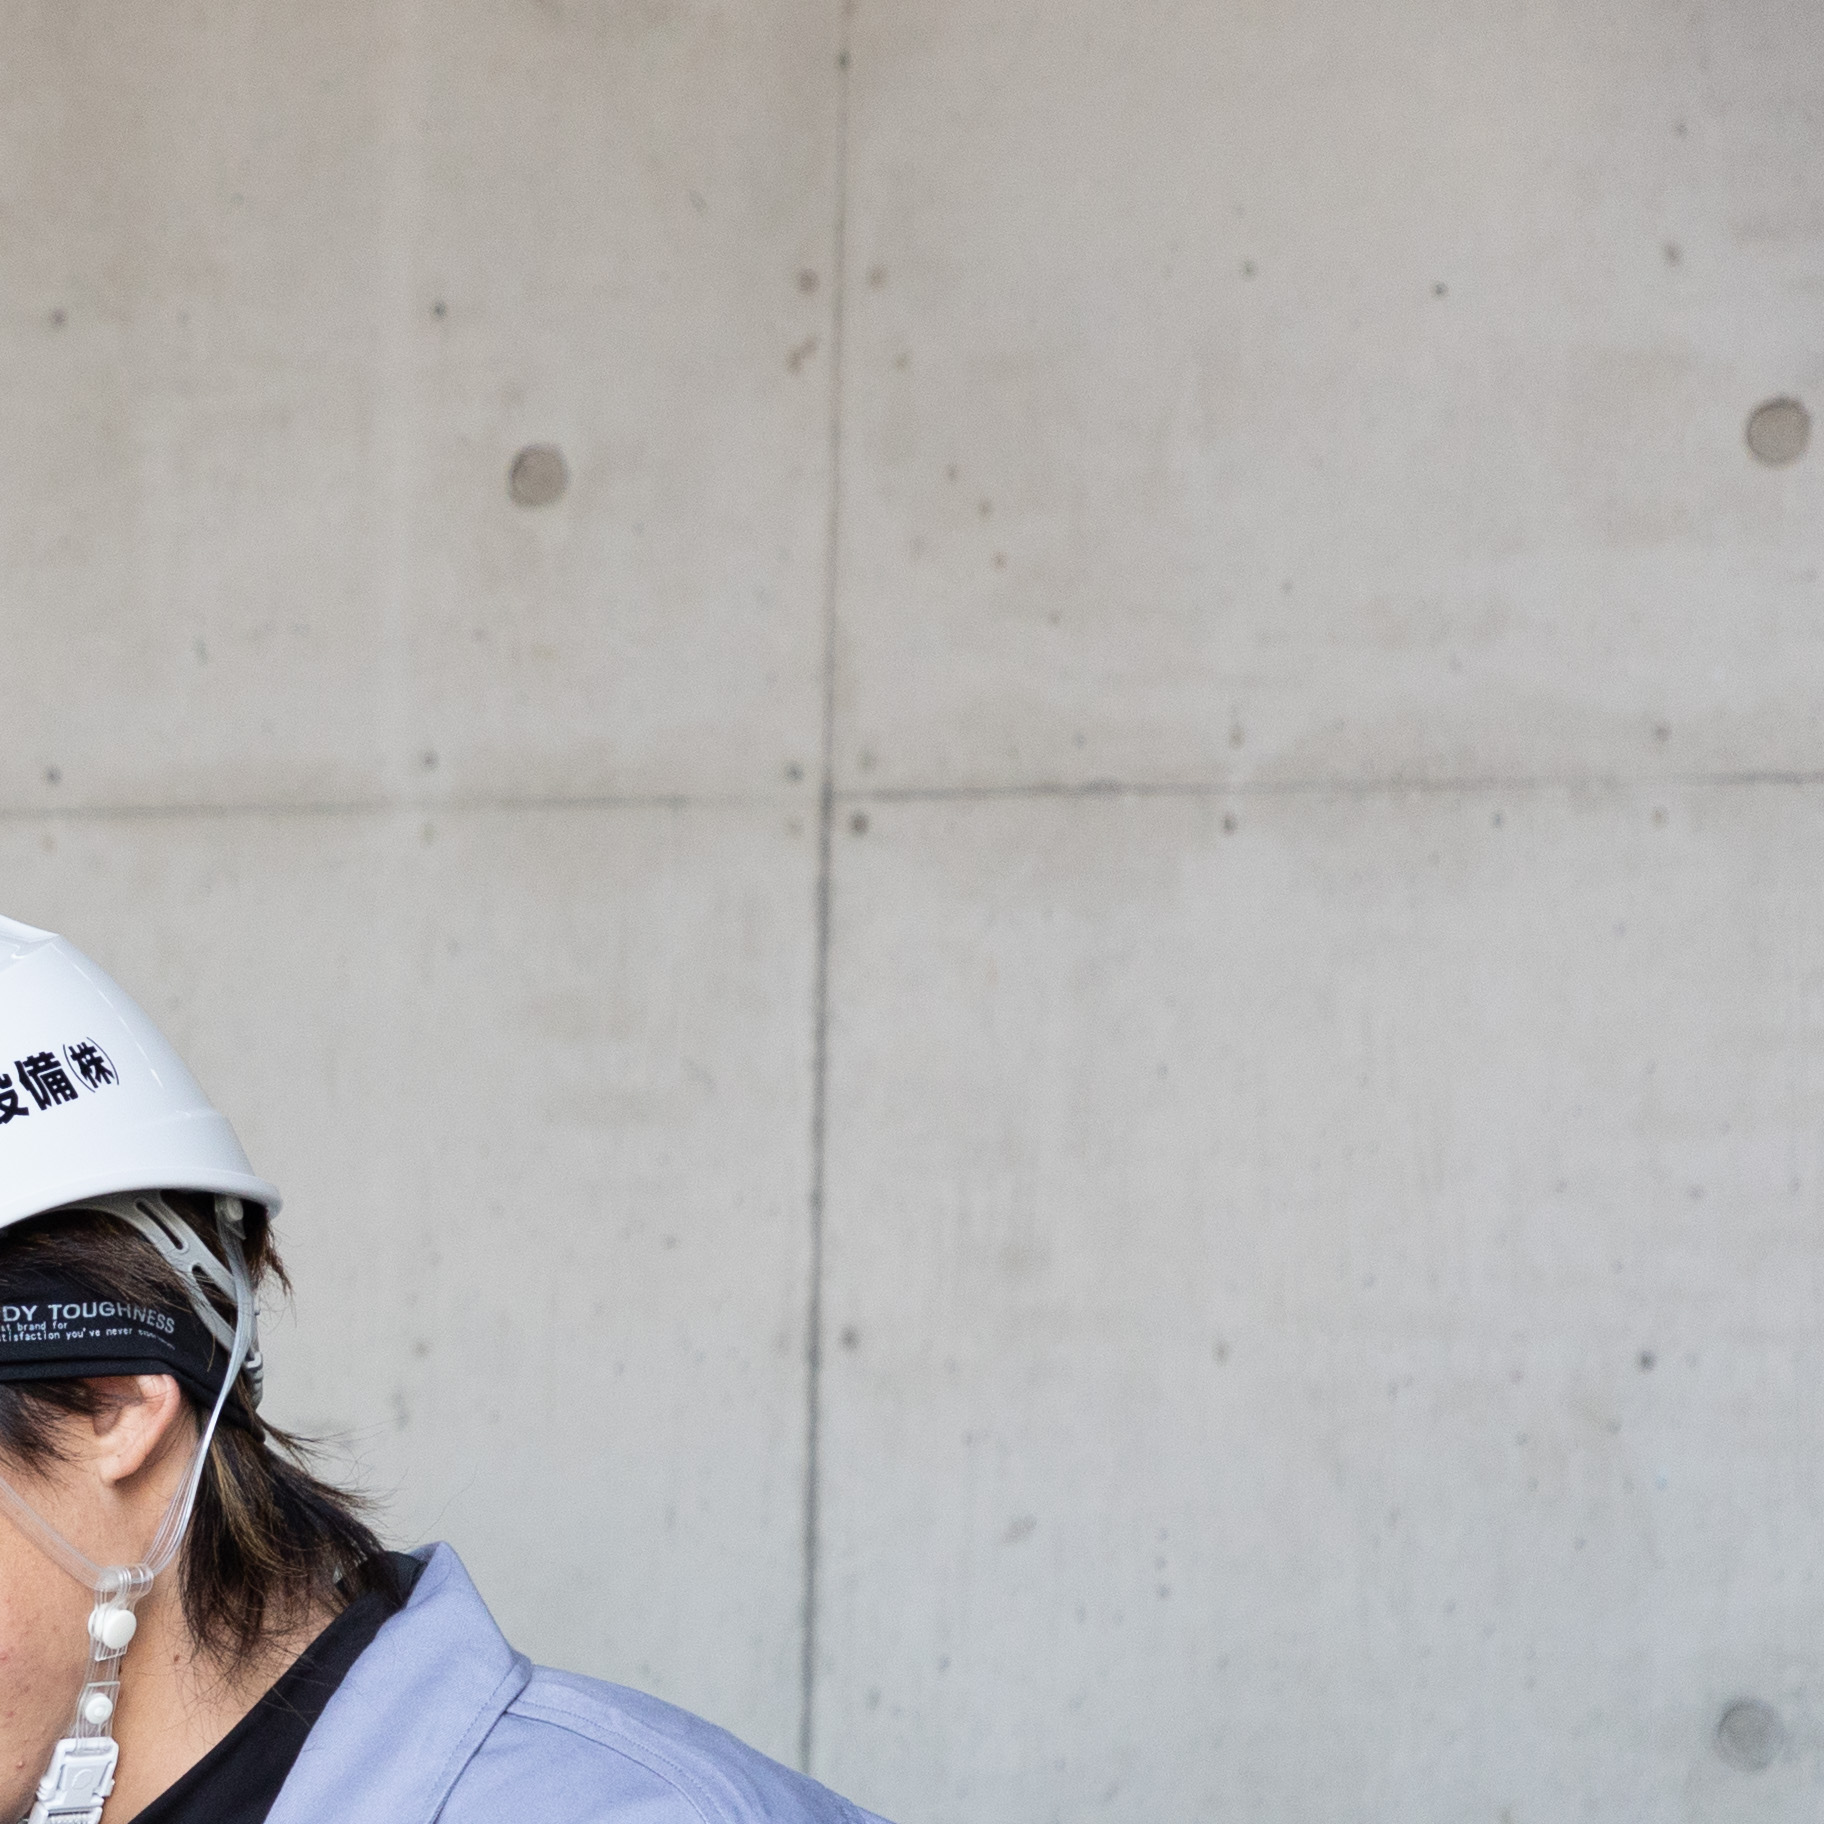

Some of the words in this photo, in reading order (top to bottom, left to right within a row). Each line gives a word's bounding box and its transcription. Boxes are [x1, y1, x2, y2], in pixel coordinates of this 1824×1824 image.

[48, 1301, 175, 1334] TOUGHNESS
[17, 1321, 47, 1332] brand
[52, 1320, 68, 1330] for
[105, 1326, 133, 1337] never
